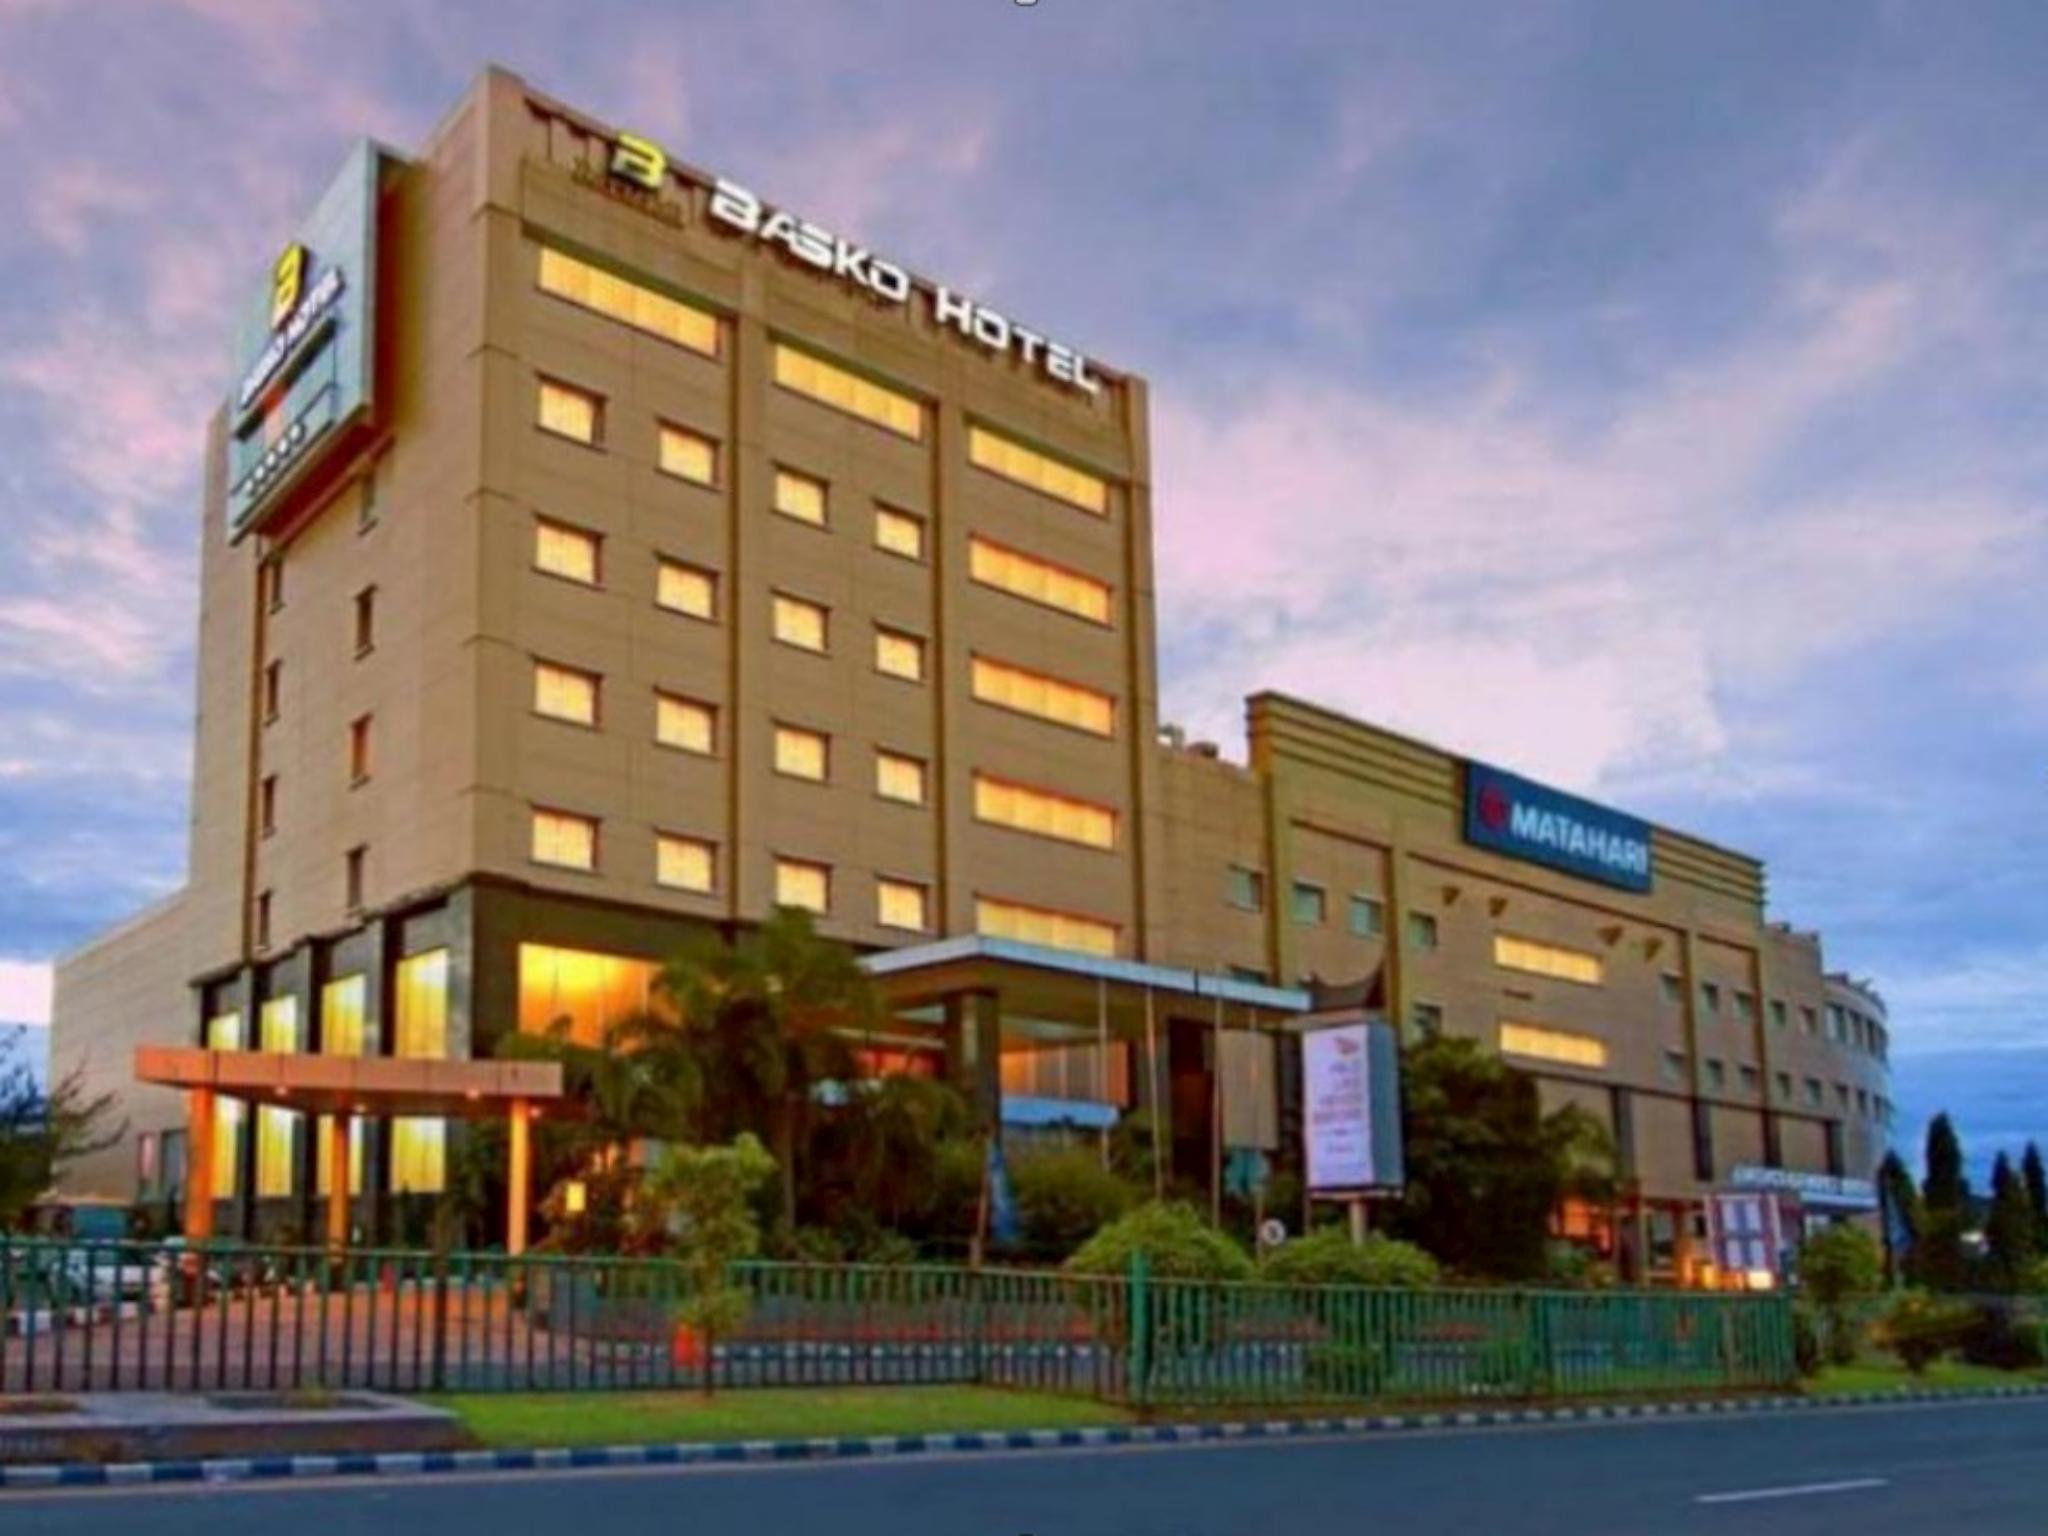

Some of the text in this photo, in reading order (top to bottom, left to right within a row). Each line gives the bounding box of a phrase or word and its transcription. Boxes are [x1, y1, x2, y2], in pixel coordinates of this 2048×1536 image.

[710, 178, 910, 302] BASKO
[936, 286, 1100, 394] HOTEL
[1510, 801, 1648, 873] MATAHARI
